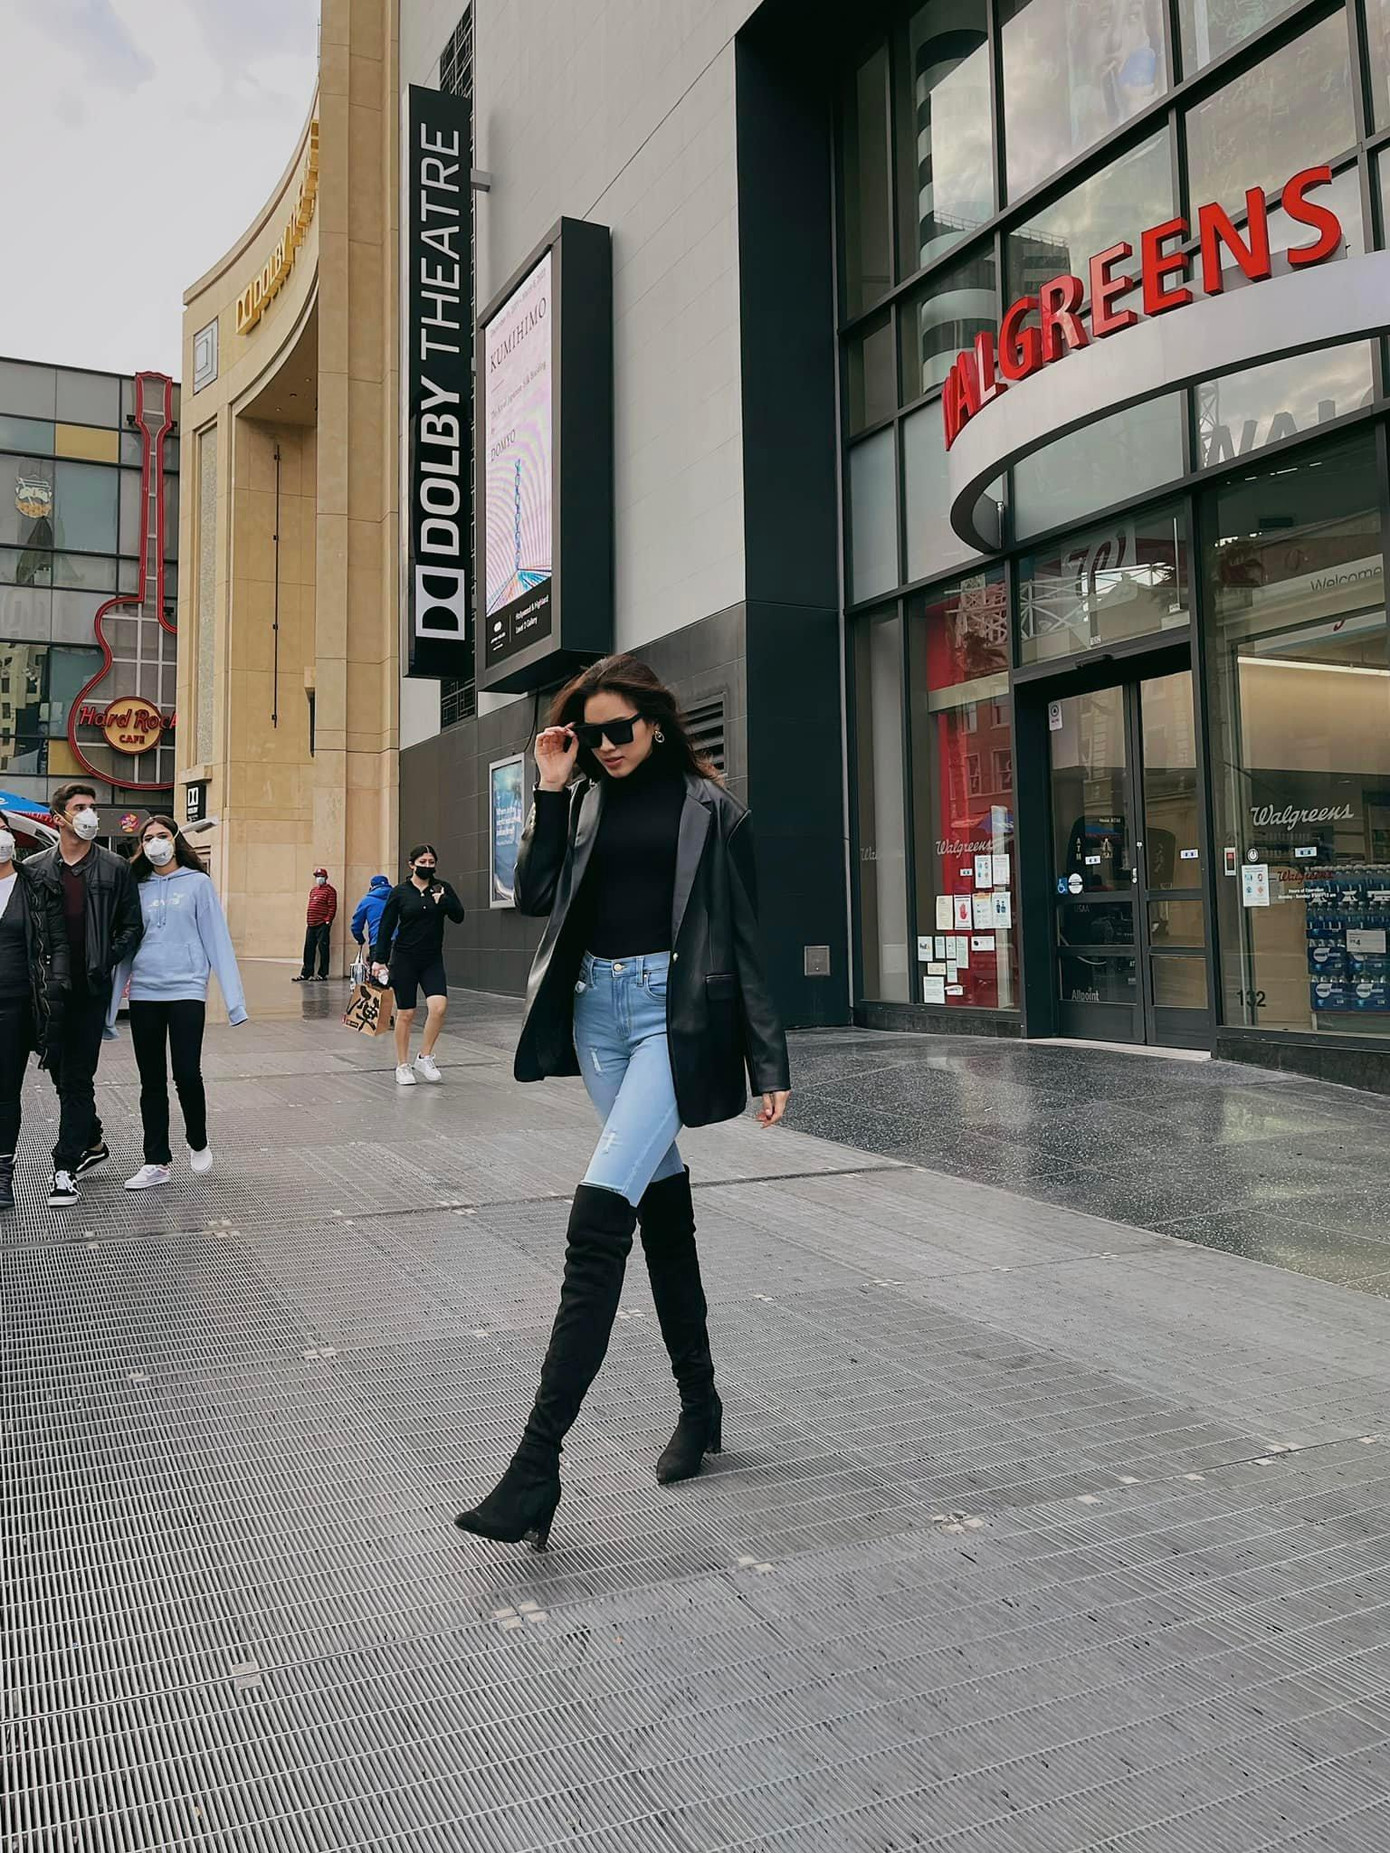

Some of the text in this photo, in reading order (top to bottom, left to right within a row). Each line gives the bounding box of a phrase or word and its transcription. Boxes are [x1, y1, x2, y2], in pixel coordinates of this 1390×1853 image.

[253, 226, 293, 310] DOLBY
[420, 121, 460, 556] DOLBY THEATRE
[490, 297, 547, 373] KUMIHIMO
[490, 428, 516, 462] DOMYO
[1310, 566, 1382, 591] Welcome
[80, 705, 132, 728] Hard
[119, 734, 145, 744] CAFE
[1250, 803, 1354, 831] Walgreens
[935, 839, 996, 858] Walgreens
